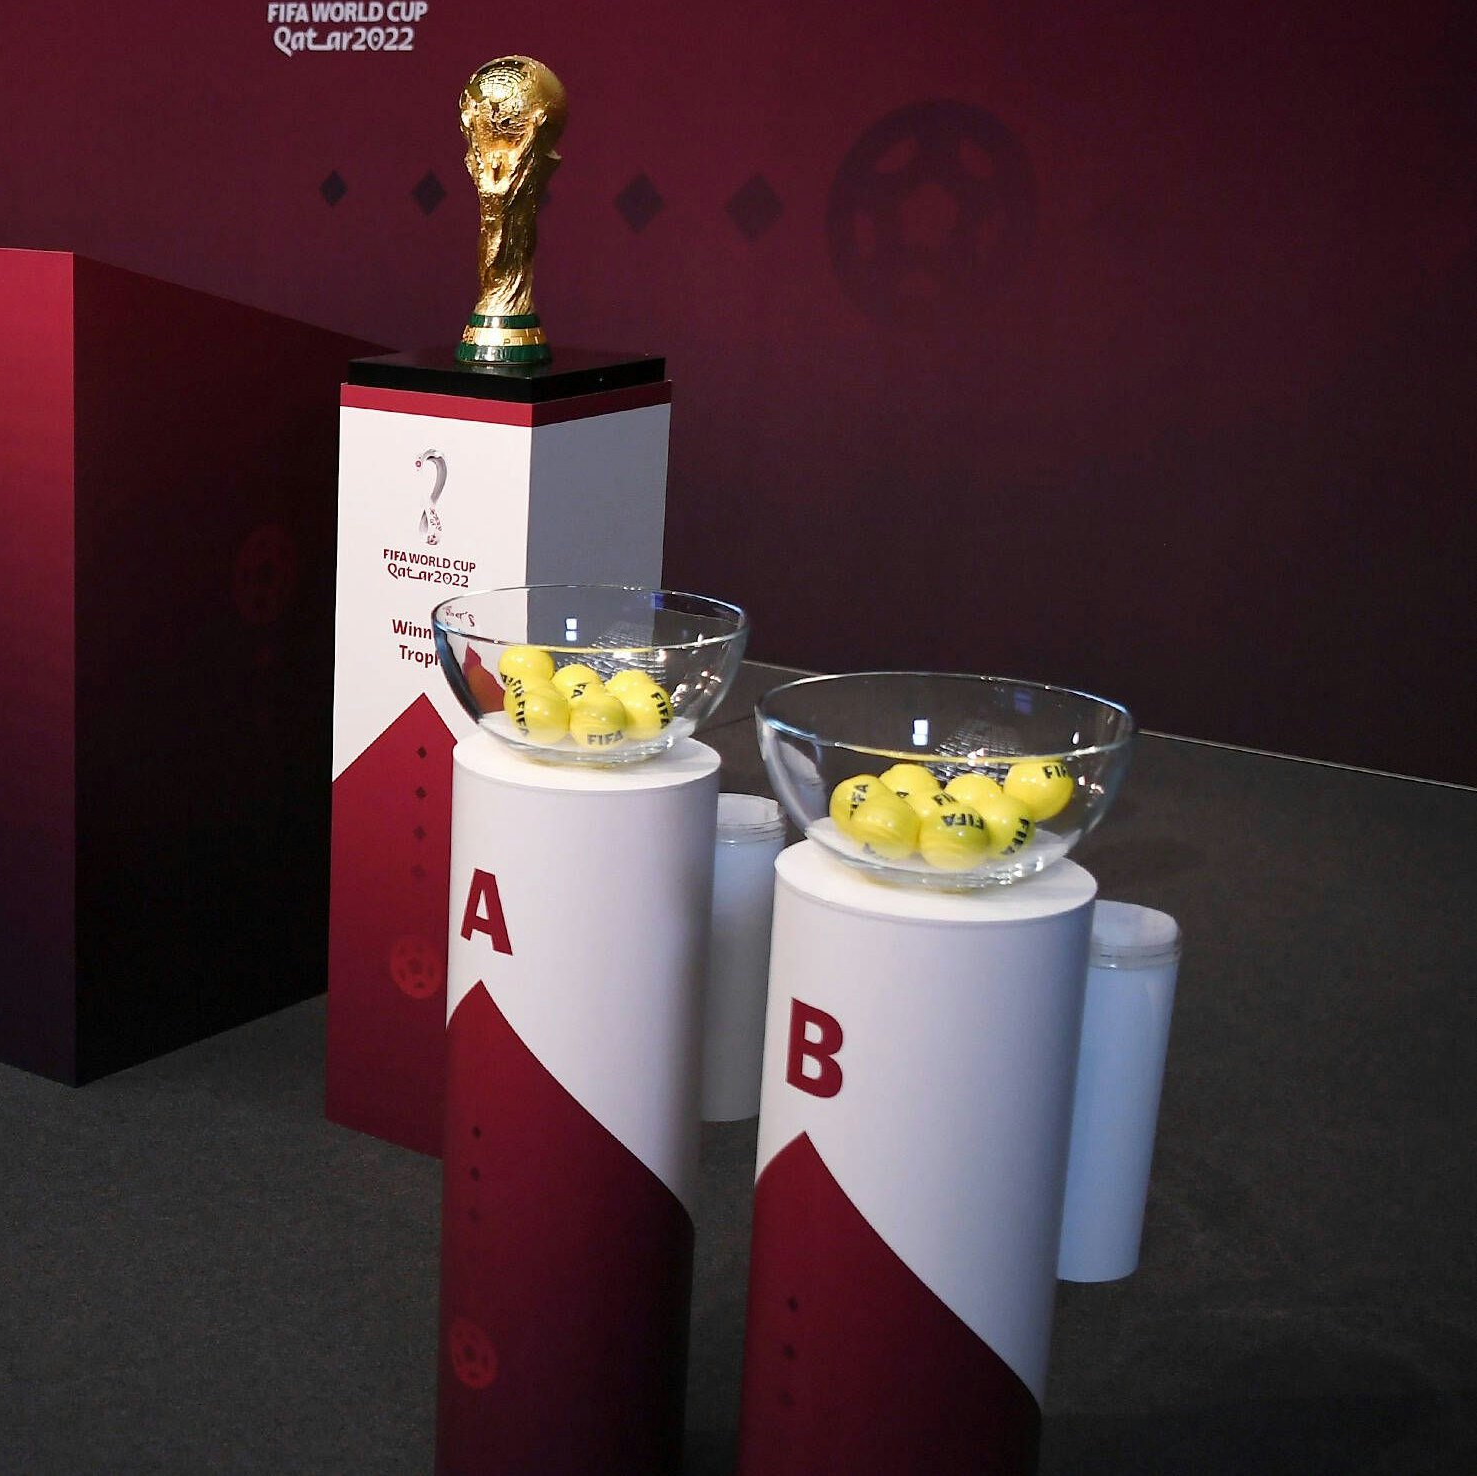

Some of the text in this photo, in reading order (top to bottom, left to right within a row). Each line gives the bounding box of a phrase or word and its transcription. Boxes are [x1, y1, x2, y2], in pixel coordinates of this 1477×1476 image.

[267, 0, 429, 24] FIFA WORLD CUP
[383, 548, 476, 574] FIFA WORLD CUP
[650, 691, 671, 730] FIFA
[586, 729, 624, 746] FIFA
[940, 812, 985, 831] FIFA
[460, 868, 514, 957] A
[786, 997, 844, 1099] B
